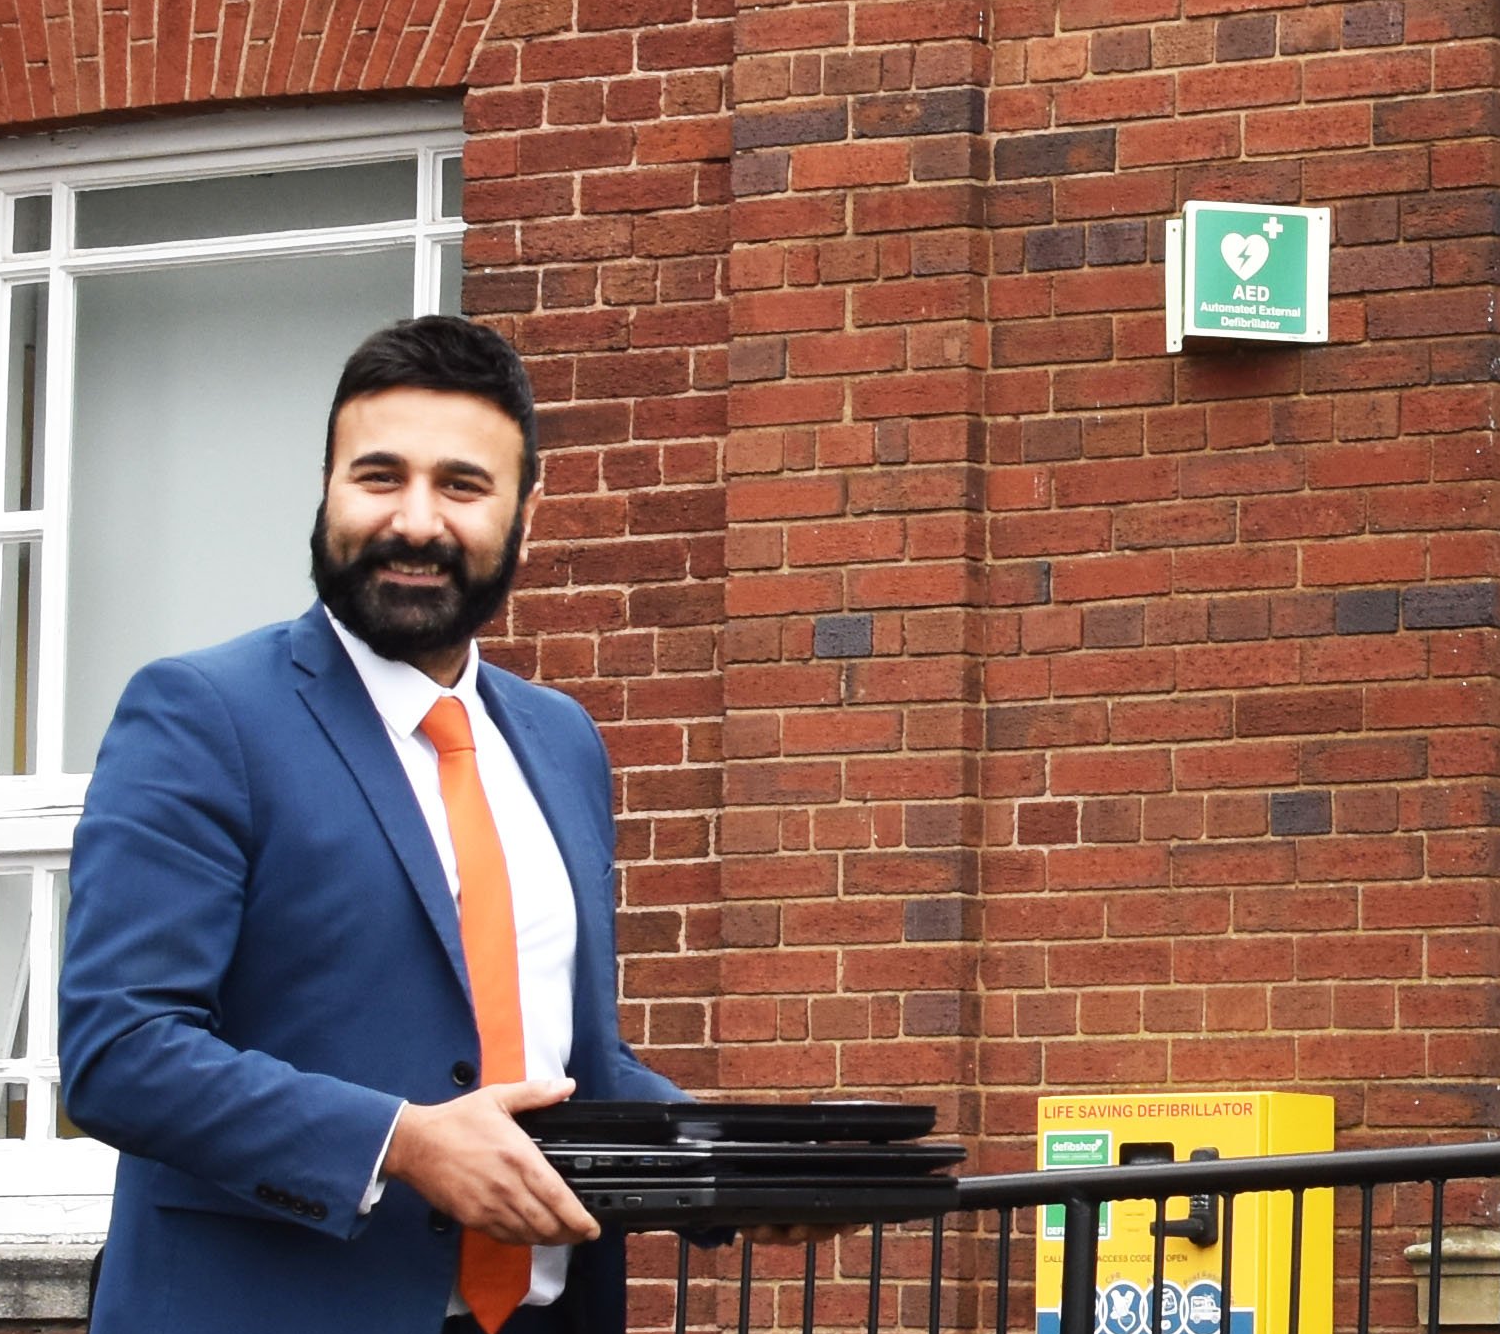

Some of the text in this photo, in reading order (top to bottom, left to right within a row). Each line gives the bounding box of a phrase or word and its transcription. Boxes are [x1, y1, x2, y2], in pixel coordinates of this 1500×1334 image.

[1233, 284, 1270, 302] AED
[1201, 302, 1300, 318] Automated External
[1221, 316, 1281, 329] Defibrillator
[1044, 1102, 1253, 1119] LIFE SAVING DEFIBRILLATOR
[1052, 1140, 1100, 1154] defibshop
